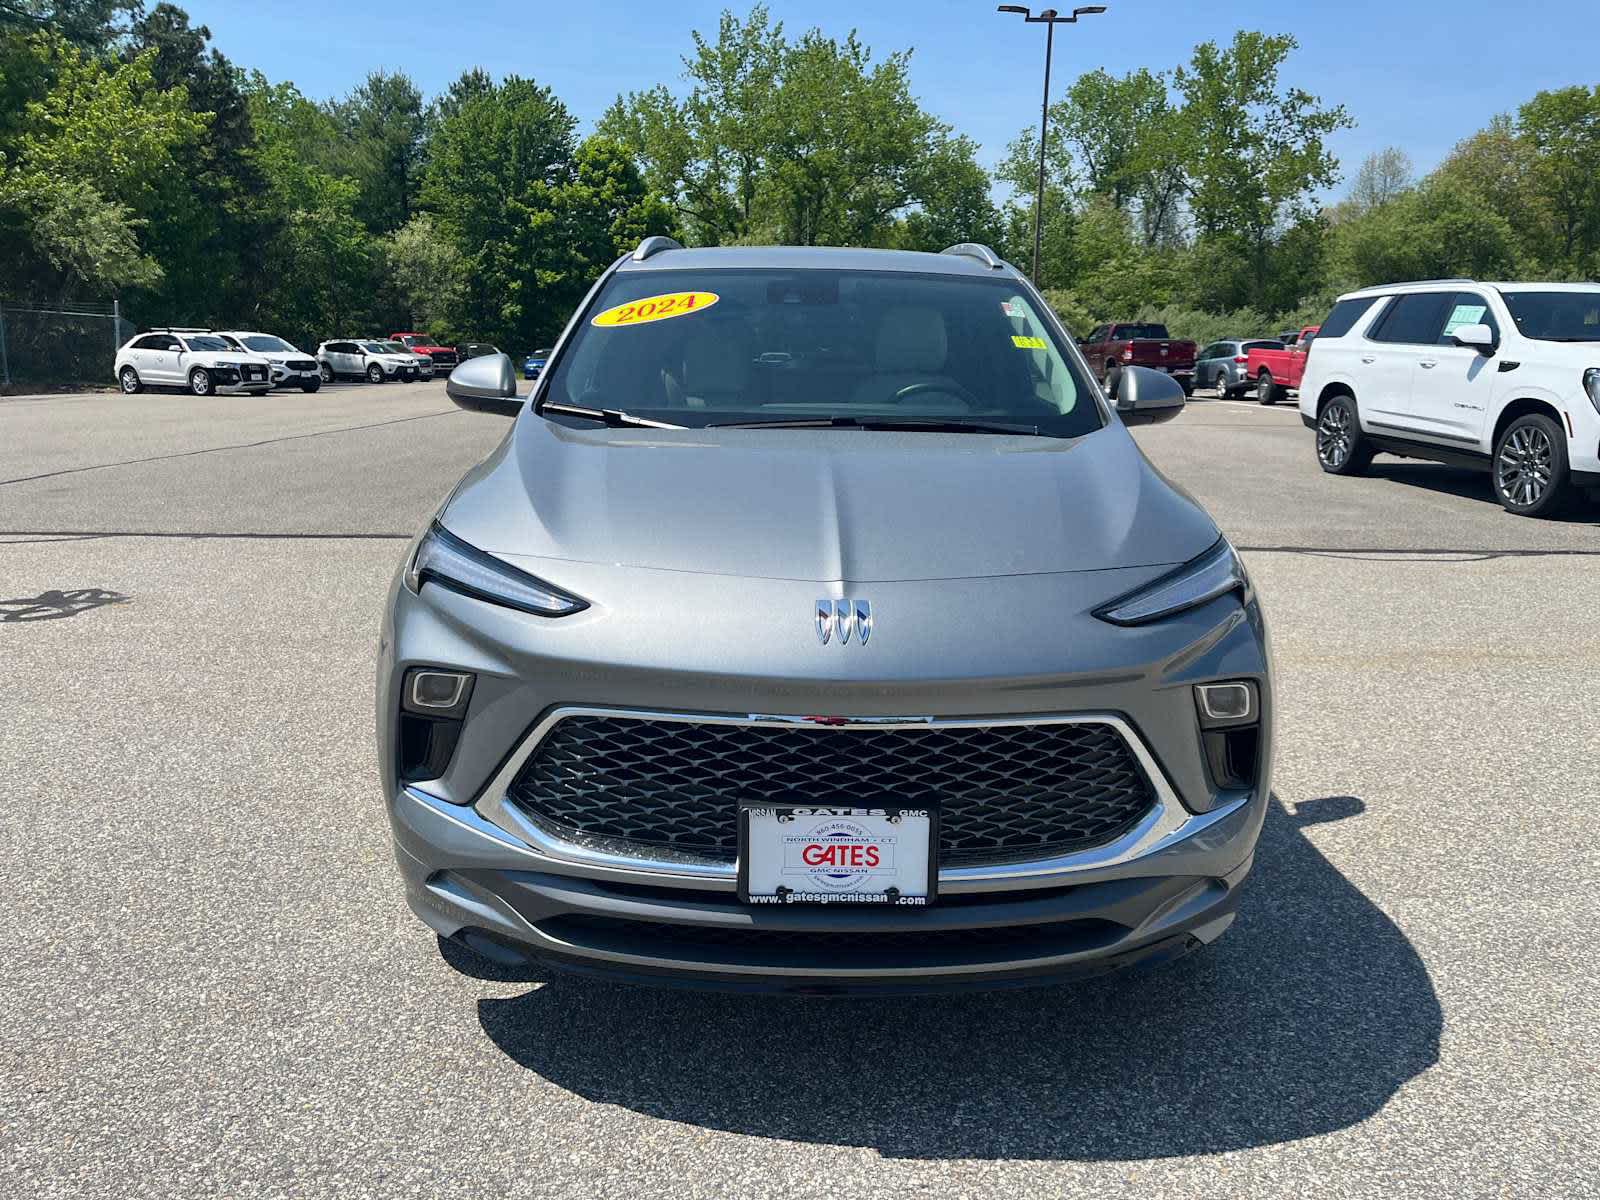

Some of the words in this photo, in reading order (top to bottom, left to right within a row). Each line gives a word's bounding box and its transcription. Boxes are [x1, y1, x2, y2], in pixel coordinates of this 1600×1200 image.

[616, 295, 695, 322] 2024
[749, 808, 777, 817] NISSAN
[792, 808, 886, 816] GATES
[899, 809, 928, 817] GMC
[802, 844, 880, 867] GATES
